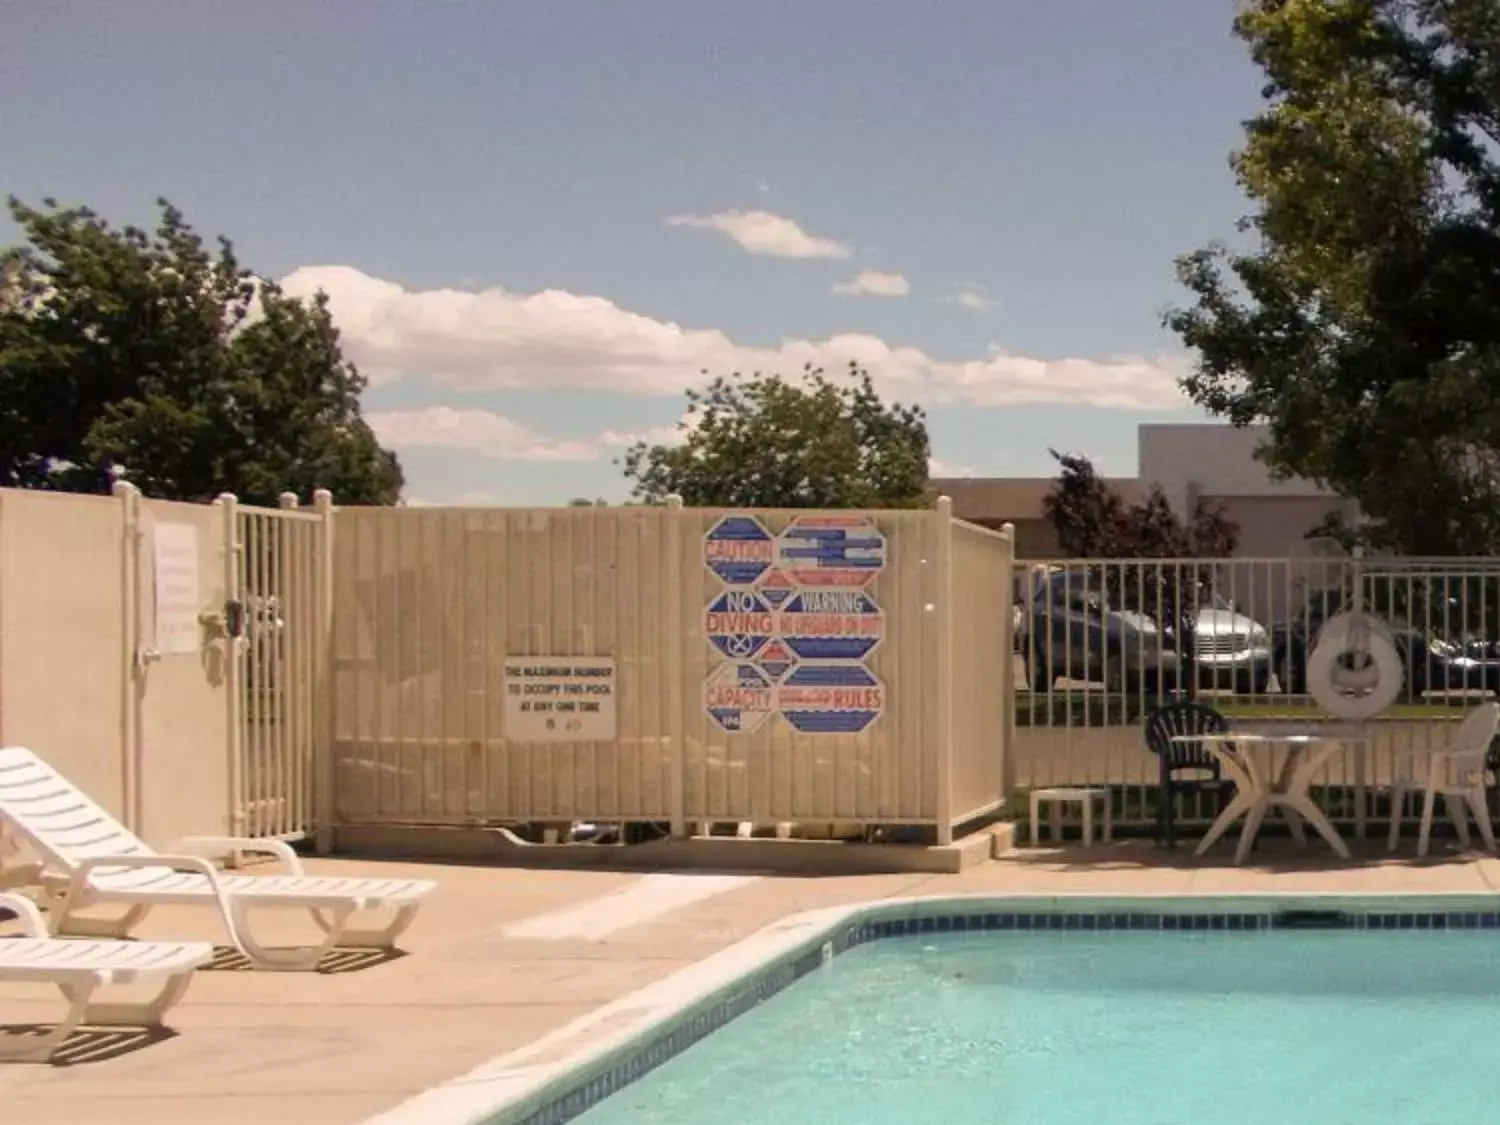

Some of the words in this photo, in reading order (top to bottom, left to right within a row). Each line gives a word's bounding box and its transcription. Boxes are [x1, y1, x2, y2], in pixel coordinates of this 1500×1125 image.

[727, 591, 755, 612] NO
[801, 591, 864, 612] WARNING
[706, 613, 773, 633] DIVING
[833, 689, 881, 709] RULES
